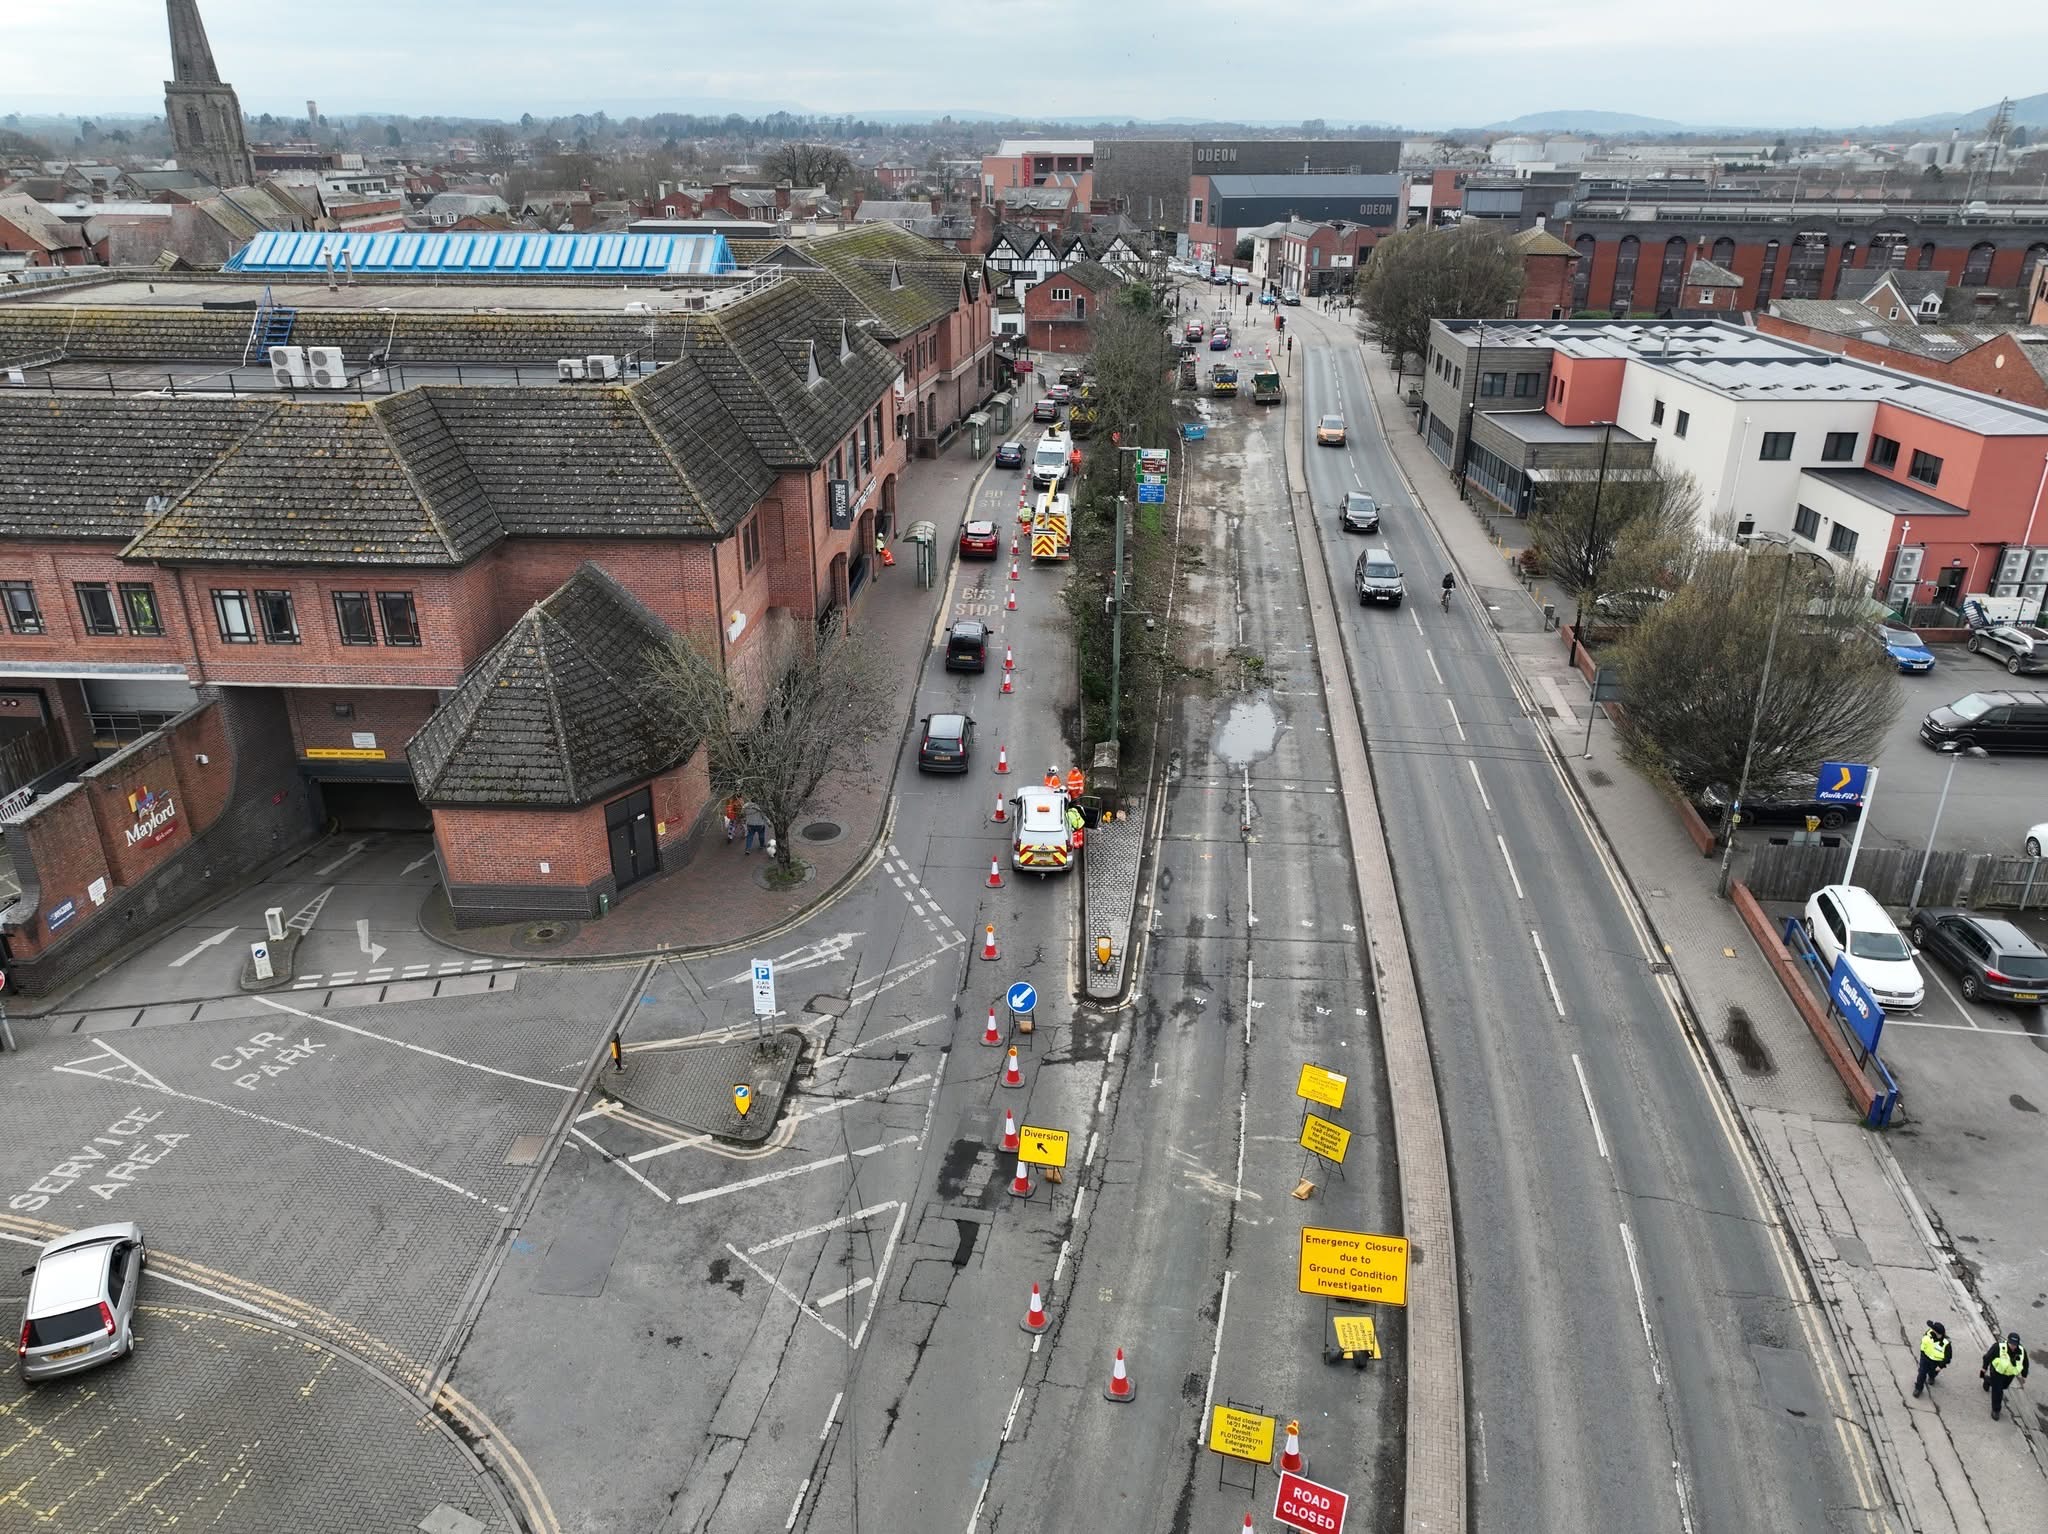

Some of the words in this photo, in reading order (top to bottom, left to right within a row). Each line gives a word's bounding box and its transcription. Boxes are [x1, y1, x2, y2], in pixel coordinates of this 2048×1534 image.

[1197, 148, 1237, 162] ODEON
[1359, 203, 1393, 215] ODEON
[962, 587, 996, 600] BUS
[955, 603, 999, 616] STOP
[124, 798, 176, 847] Maylord
[211, 1031, 284, 1071] CAR
[232, 1037, 327, 1091] PARK
[1024, 1129, 1064, 1142] Diversion
[9, 1107, 164, 1211] SERVICE
[89, 1133, 191, 1201] AREA
[1305, 1234, 1360, 1249] Emergency
[1365, 1241, 1404, 1253] Closure
[1339, 1253, 1358, 1263] due
[1361, 1255, 1371, 1264] to
[1309, 1263, 1346, 1275] Ground
[1350, 1268, 1398, 1282] Condition
[1318, 1278, 1383, 1293] Investigation
[1226, 1413, 1242, 1422] Road
[1242, 1418, 1262, 1427] closed
[1241, 1424, 1260, 1432] March
[1225, 1438, 1257, 1451] Emergency
[1293, 1487, 1330, 1510] ROAD
[1283, 1501, 1335, 1530] CLOSED
